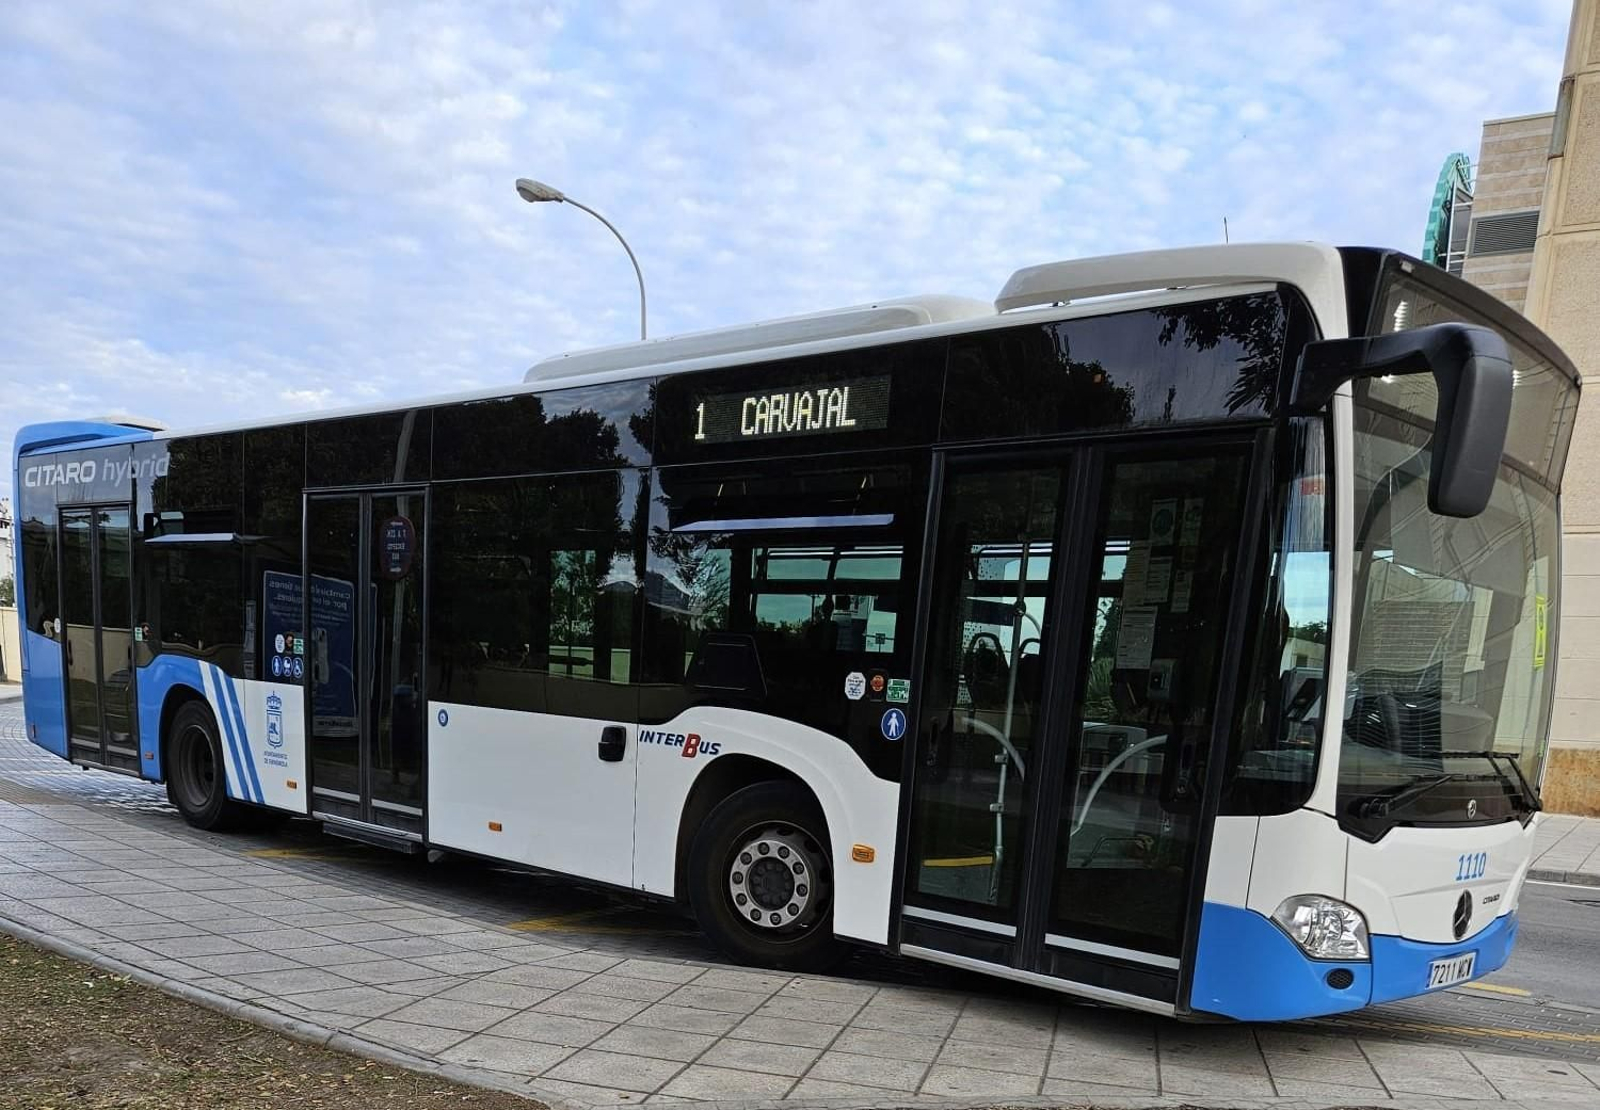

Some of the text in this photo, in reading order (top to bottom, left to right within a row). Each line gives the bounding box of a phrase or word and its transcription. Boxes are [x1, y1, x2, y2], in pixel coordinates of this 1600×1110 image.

[694, 386, 856, 440] 1 CARVAJAL
[24, 452, 170, 487] CITARO hybrid
[1455, 851, 1487, 881] 1110
[1431, 962, 1457, 985] 7211
